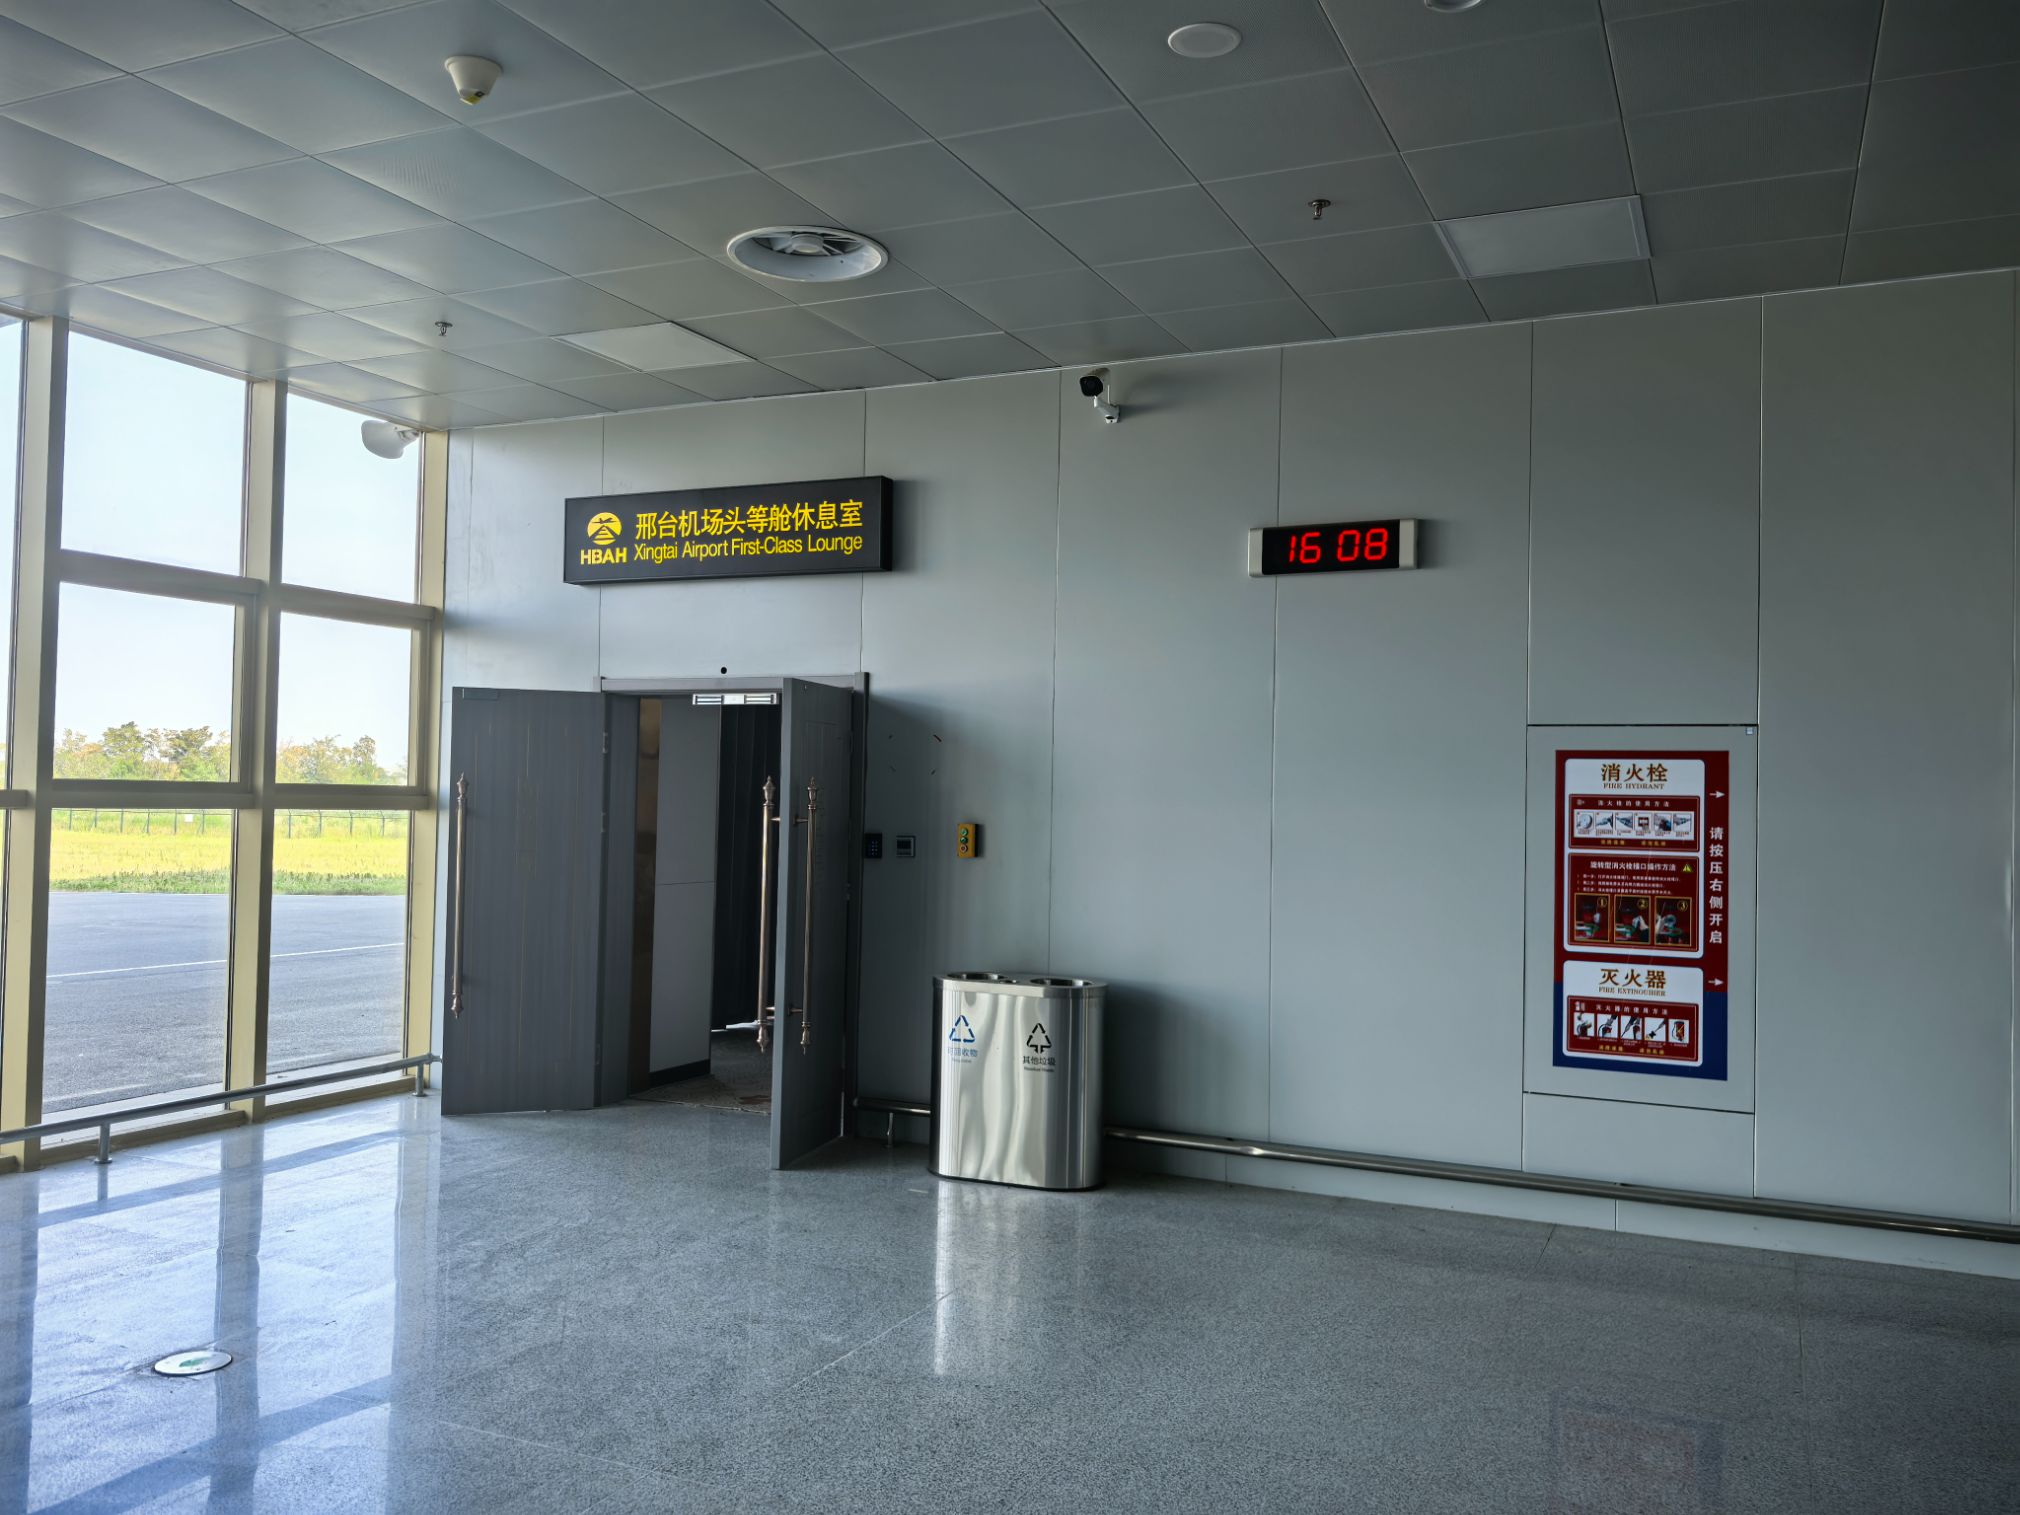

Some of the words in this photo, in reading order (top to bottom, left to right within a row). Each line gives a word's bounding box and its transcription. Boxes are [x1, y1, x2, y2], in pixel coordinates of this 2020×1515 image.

[635, 499, 864, 541] 邢台机场头等舱休息室
[580, 547, 627, 565] HBAH
[633, 541, 679, 563] Xingtai
[682, 539, 729, 562] Airport
[731, 535, 803, 557] First-Class
[807, 533, 863, 555] Lounge
[1288, 532, 1321, 564] 16
[1336, 528, 1388, 563] 08
[1601, 763, 1668, 782] 消火栓
[1709, 827, 1724, 944] 请按压右侧开启
[1599, 968, 1667, 989] 灭火器
[1023, 1056, 1056, 1067] 其他垃圾
